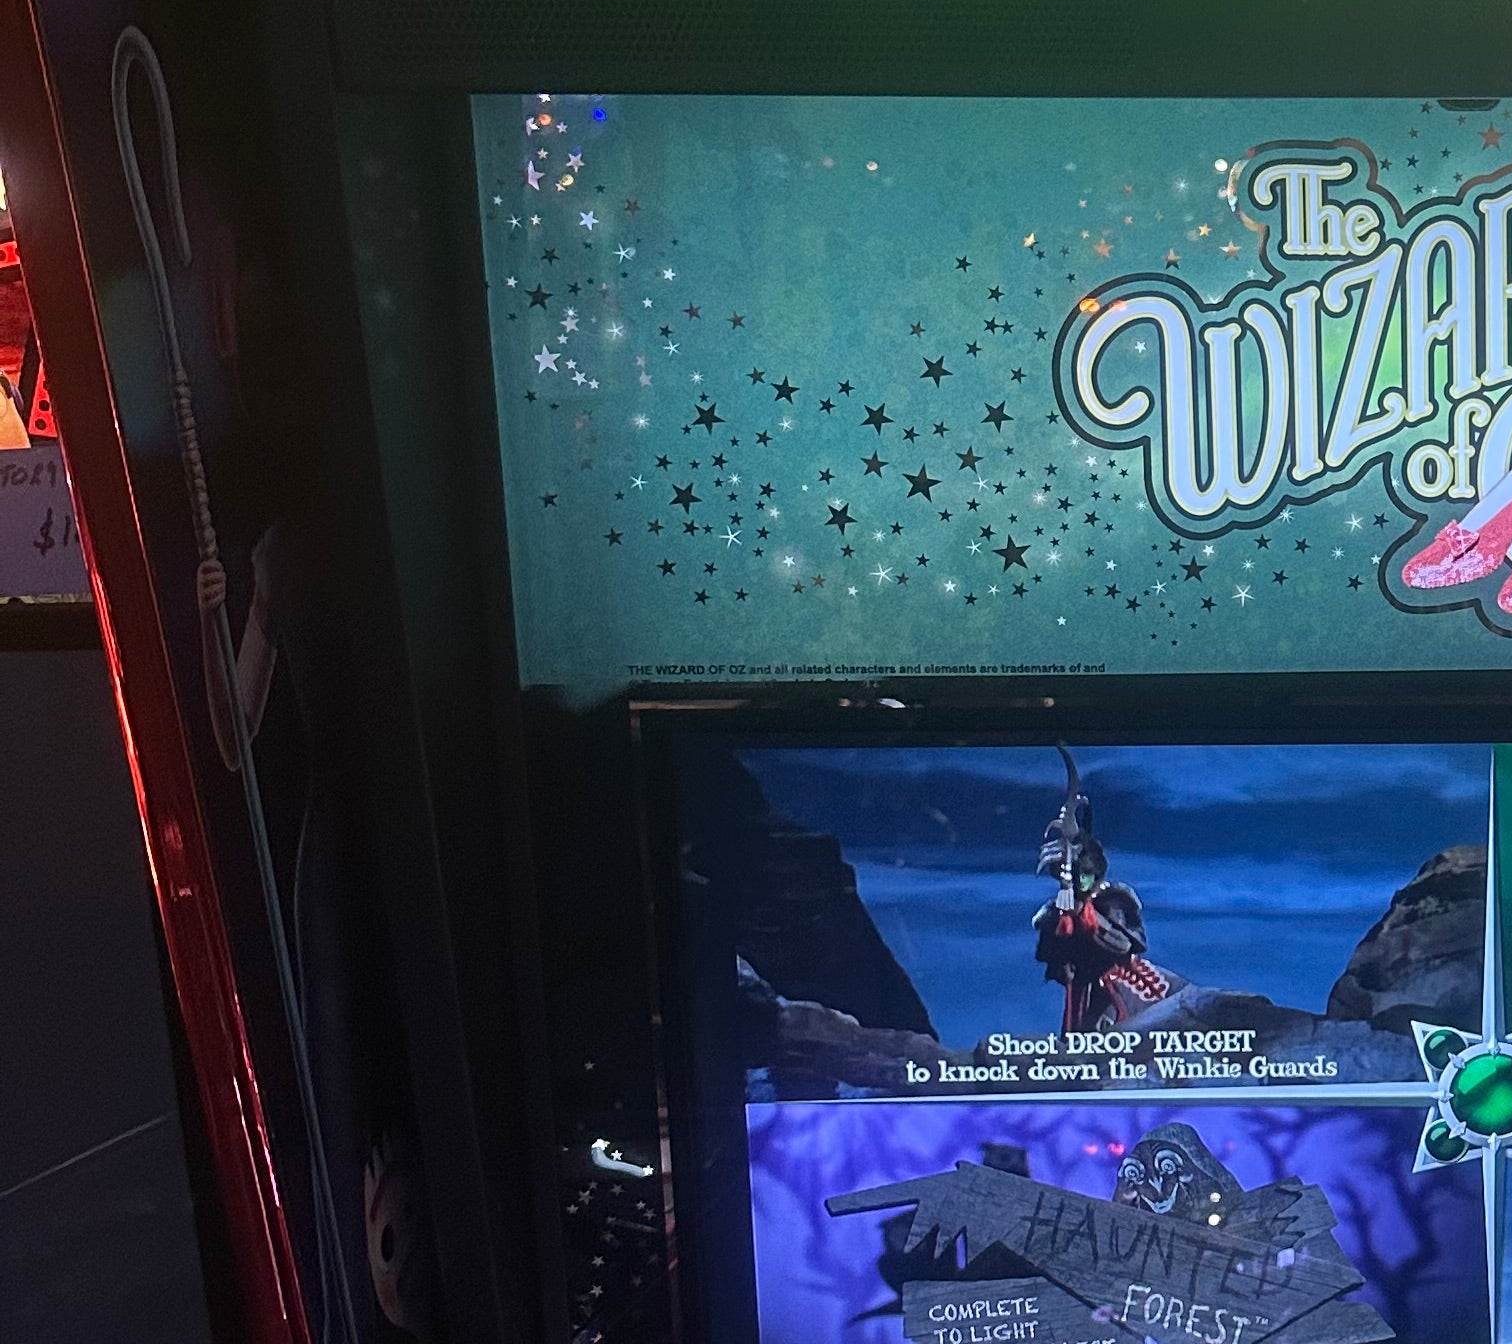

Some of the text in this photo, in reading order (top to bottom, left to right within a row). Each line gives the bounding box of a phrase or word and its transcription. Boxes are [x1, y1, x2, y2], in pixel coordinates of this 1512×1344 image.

[1254, 162, 1382, 256] The
[1406, 391, 1492, 499] of
[32, 506, 80, 559] $1
[628, 662, 1106, 675] THE WIZARD OF OZ and all related characters and elements are trademarks of and
[987, 1029, 1257, 1057] Shoot DROP TARGET
[905, 1055, 1338, 1084] to knock down the Winkie Guards
[1021, 1190, 1295, 1300] HAUNTED
[928, 1296, 1040, 1323] COMPLETE
